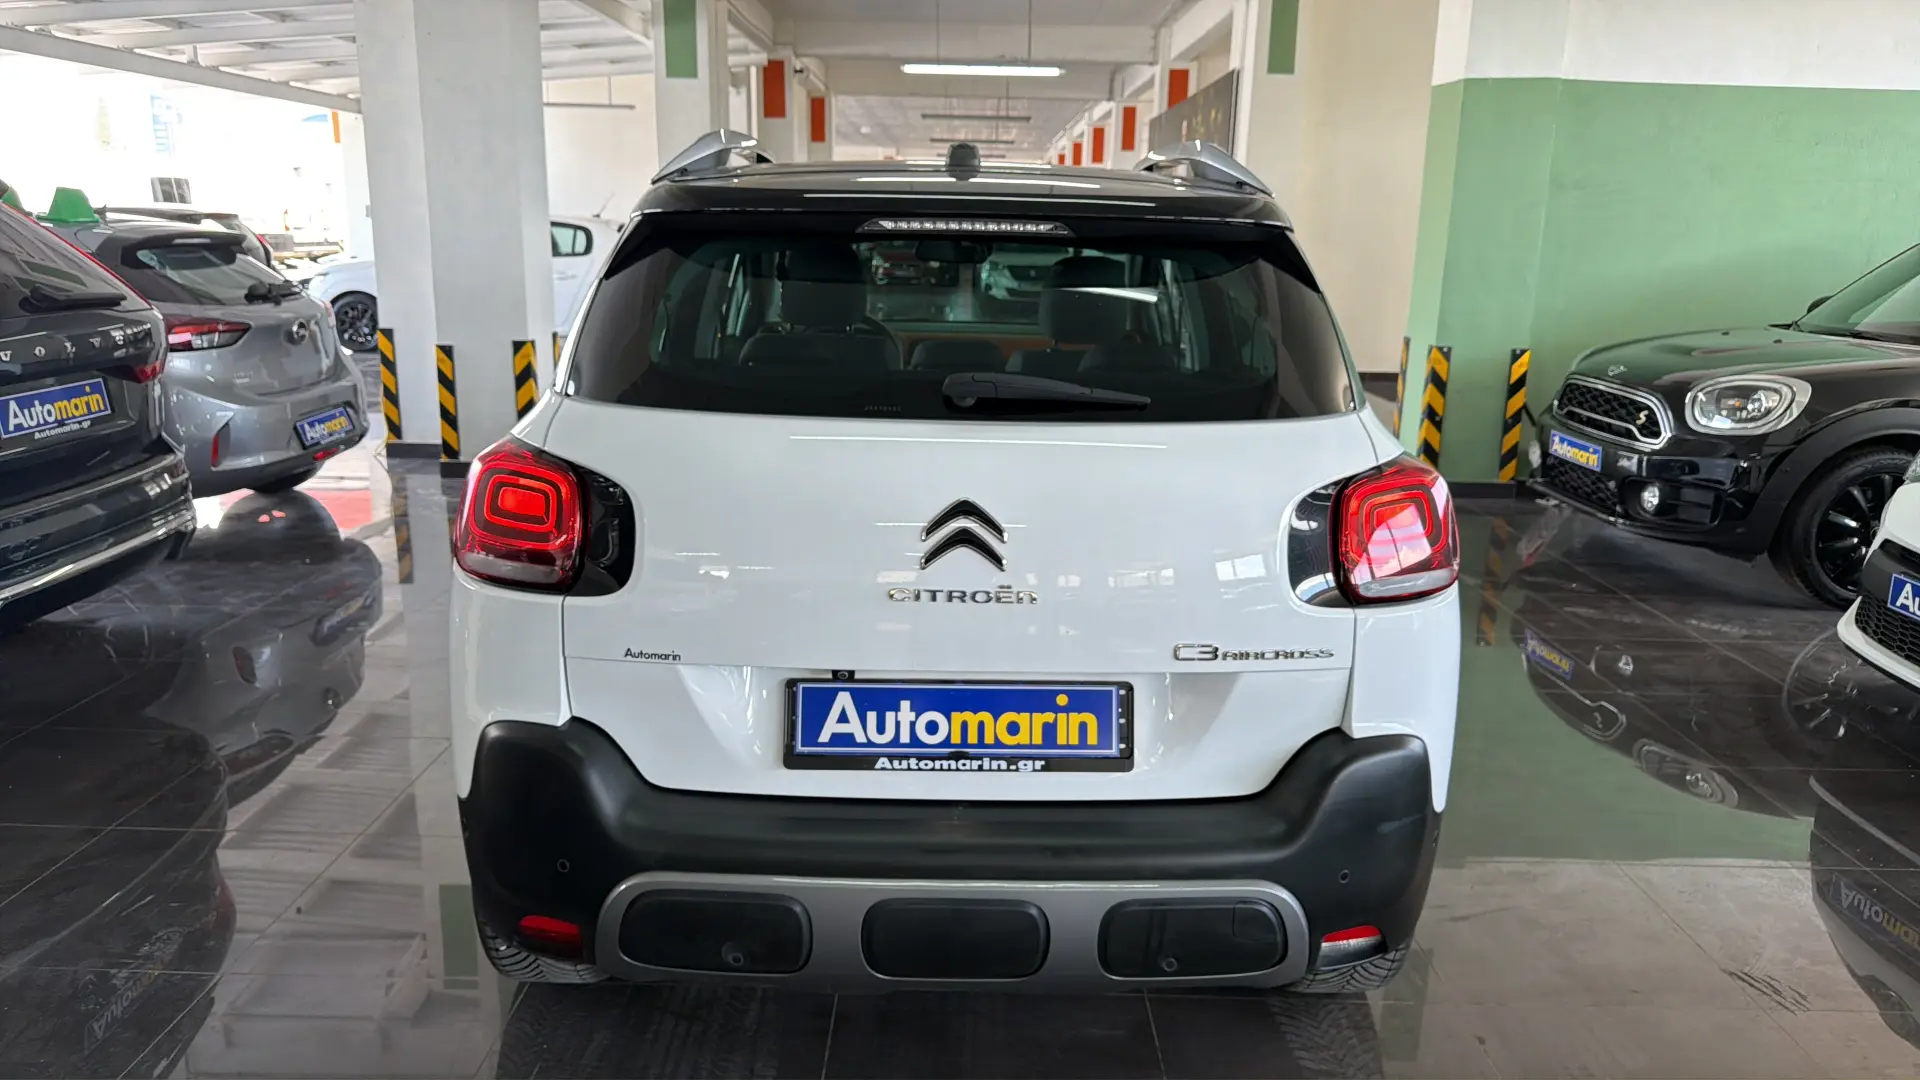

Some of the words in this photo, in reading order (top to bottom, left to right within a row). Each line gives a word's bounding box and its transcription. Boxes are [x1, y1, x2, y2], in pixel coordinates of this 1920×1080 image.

[8, 385, 105, 432] Automarin
[34, 420, 91, 440] Automarin.gr
[303, 412, 349, 441] Automarin
[1551, 435, 1598, 468] Automarin
[624, 647, 681, 662] Automarin
[1174, 643, 1219, 661] C3
[1221, 648, 1334, 661] AIRCROSS
[817, 690, 1098, 746] Automarin
[874, 756, 1046, 772] Automarin.gr
